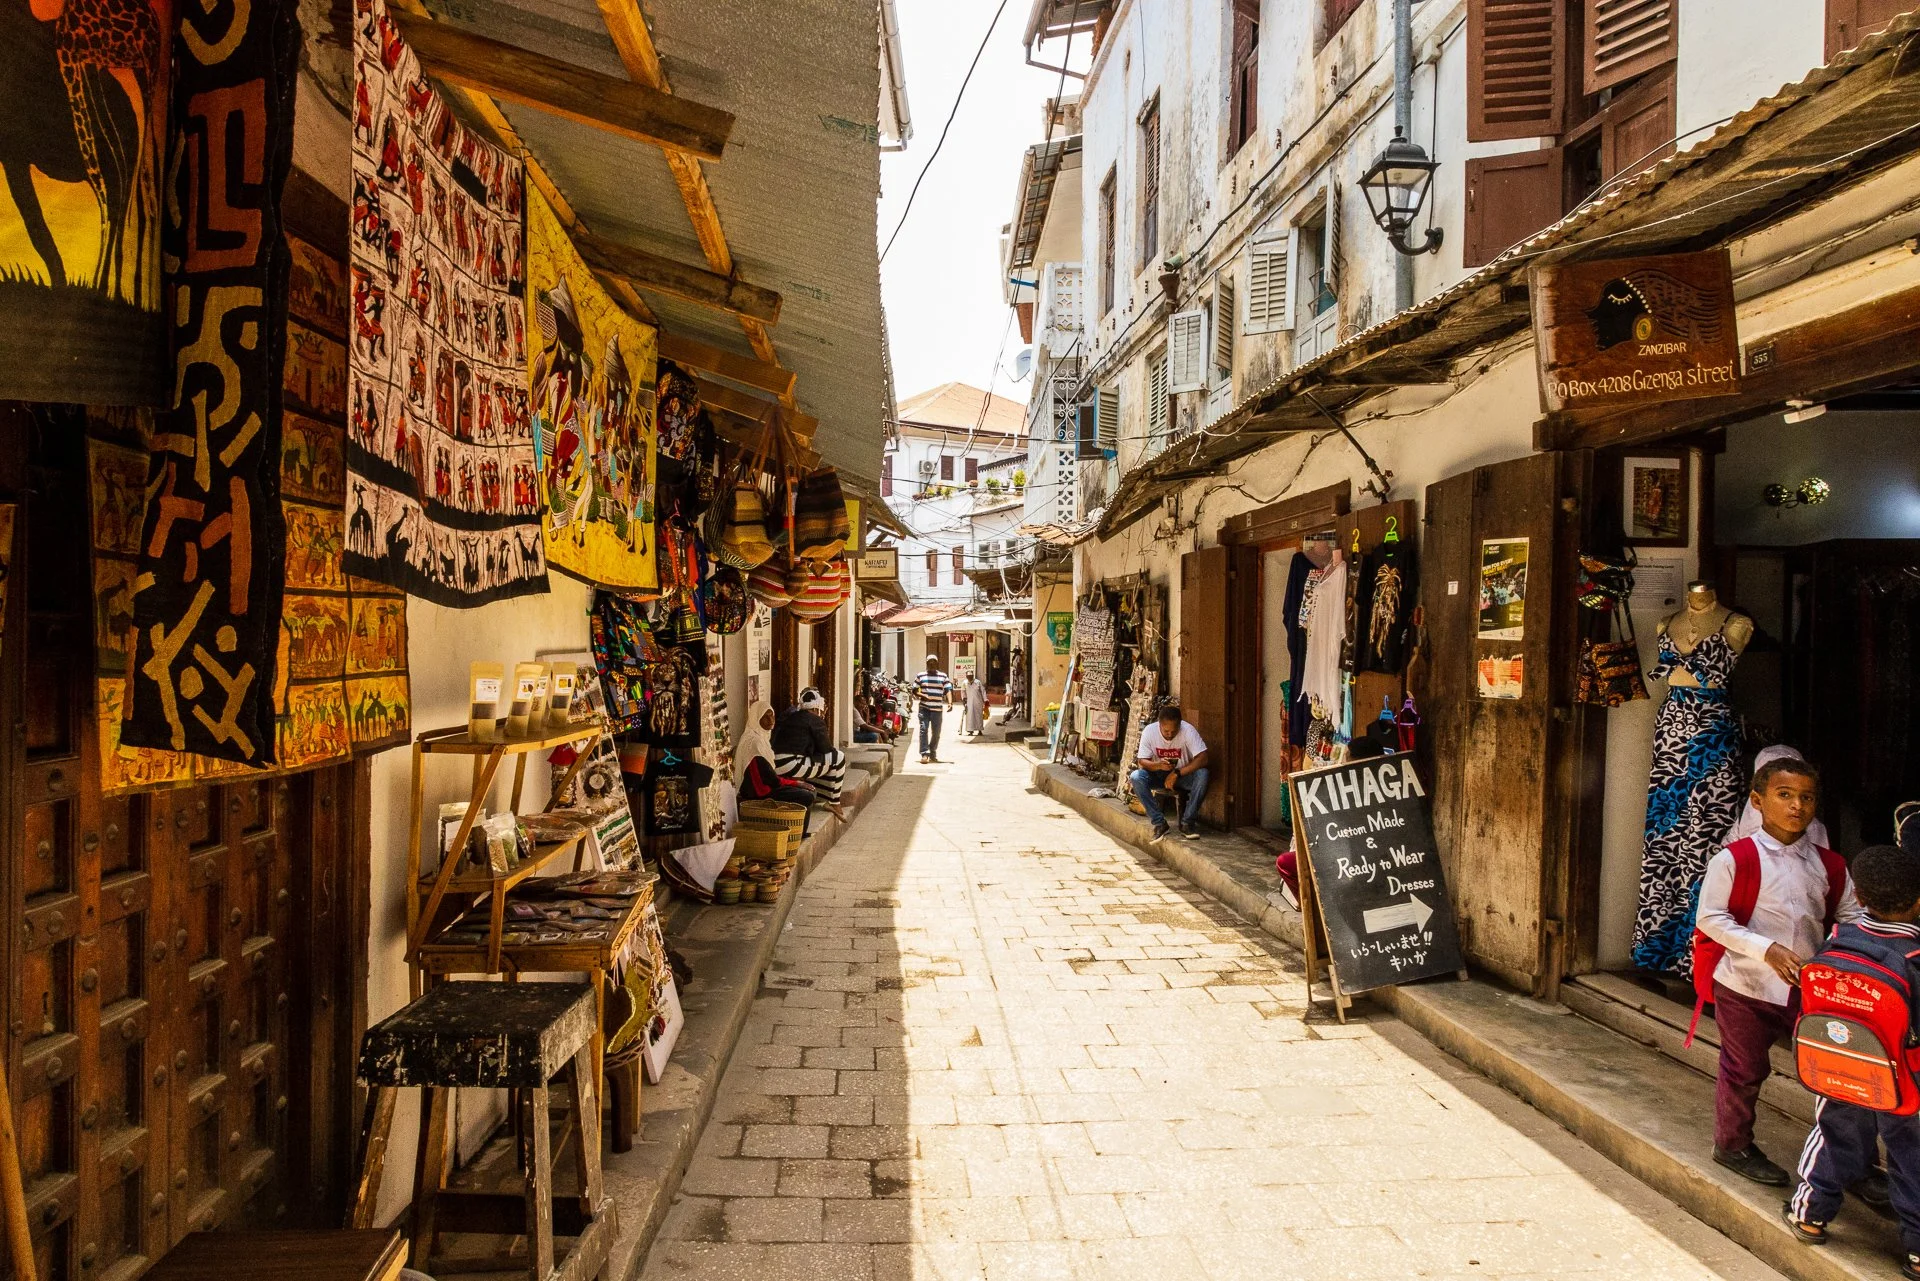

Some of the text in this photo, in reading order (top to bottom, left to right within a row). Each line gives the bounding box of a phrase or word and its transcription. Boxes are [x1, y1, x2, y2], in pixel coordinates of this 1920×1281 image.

[1637, 341, 1687, 357] ZANZIBAR
[1598, 375, 1632, 394] 4208
[1297, 759, 1426, 818] KIHAGA
[1326, 822, 1368, 841] Custom
[1367, 809, 1405, 832] Made
[1366, 837, 1378, 849] &
[1337, 845, 1426, 883] Ready to Wear
[1386, 875, 1435, 896] Dresses
[1389, 951, 1428, 972] キハガ
